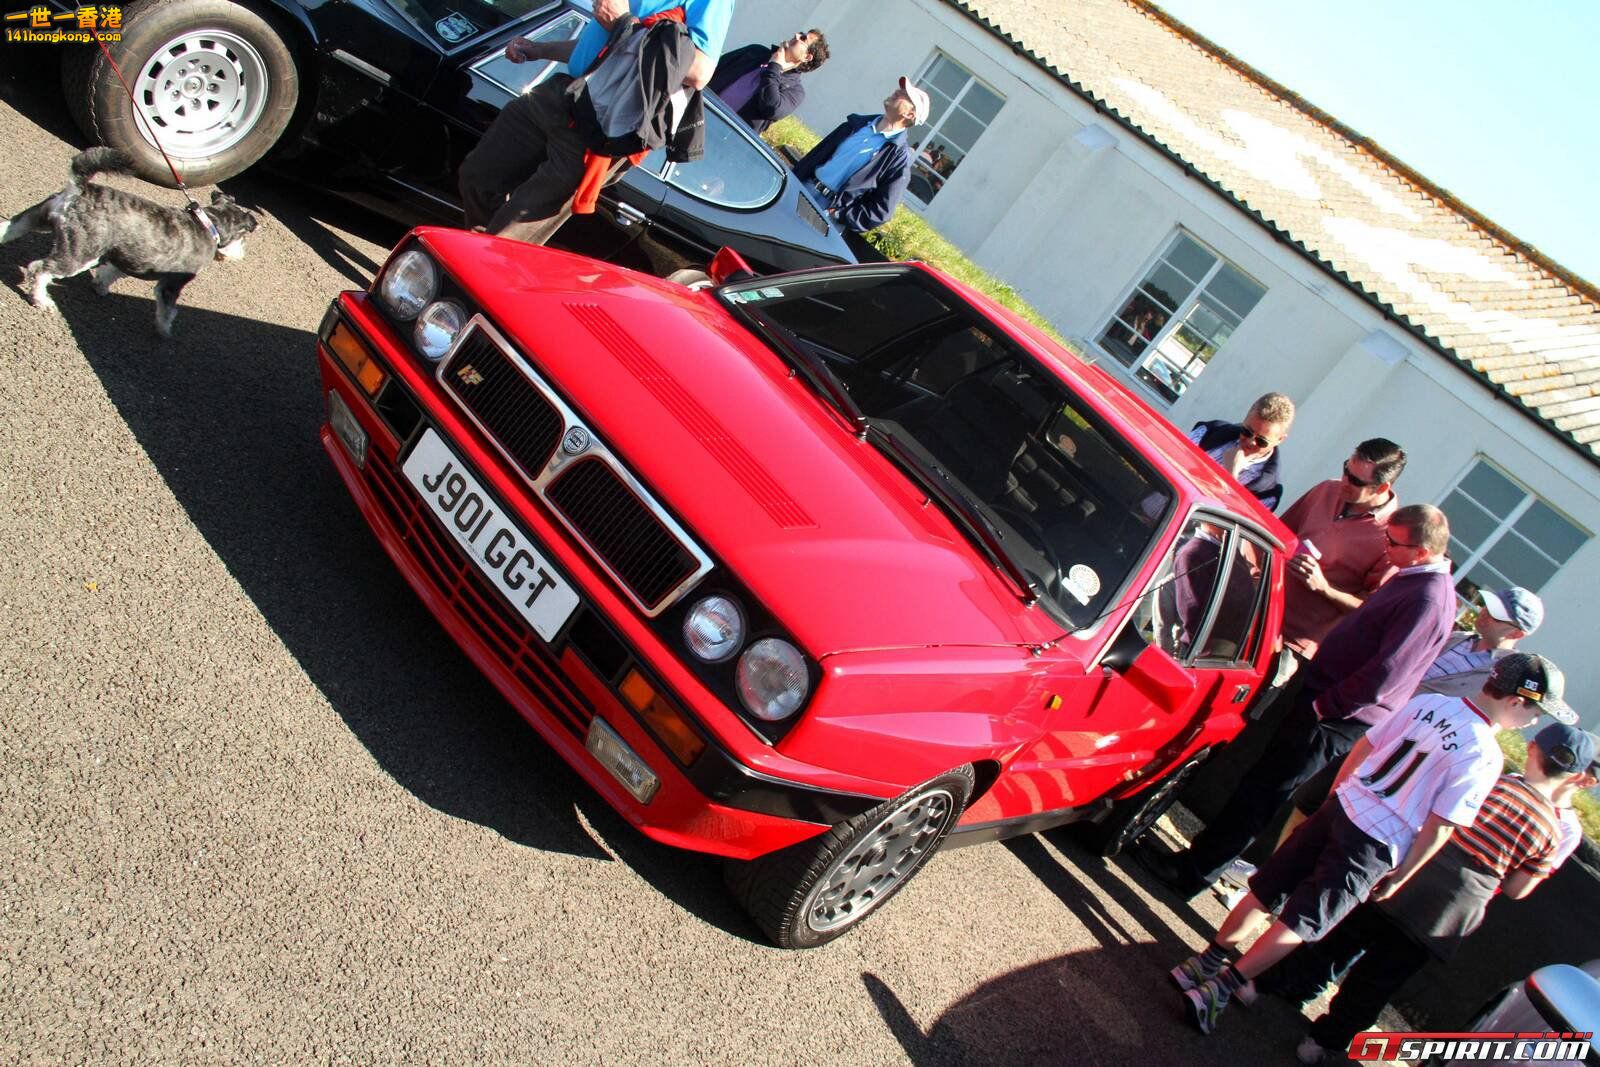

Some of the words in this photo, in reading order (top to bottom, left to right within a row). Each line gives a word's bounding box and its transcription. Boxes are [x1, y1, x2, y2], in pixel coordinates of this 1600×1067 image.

[423, 462, 493, 544] J901
[484, 528, 557, 609] GGT
[1413, 708, 1458, 752] JAMES
[1360, 738, 1429, 798] 11
